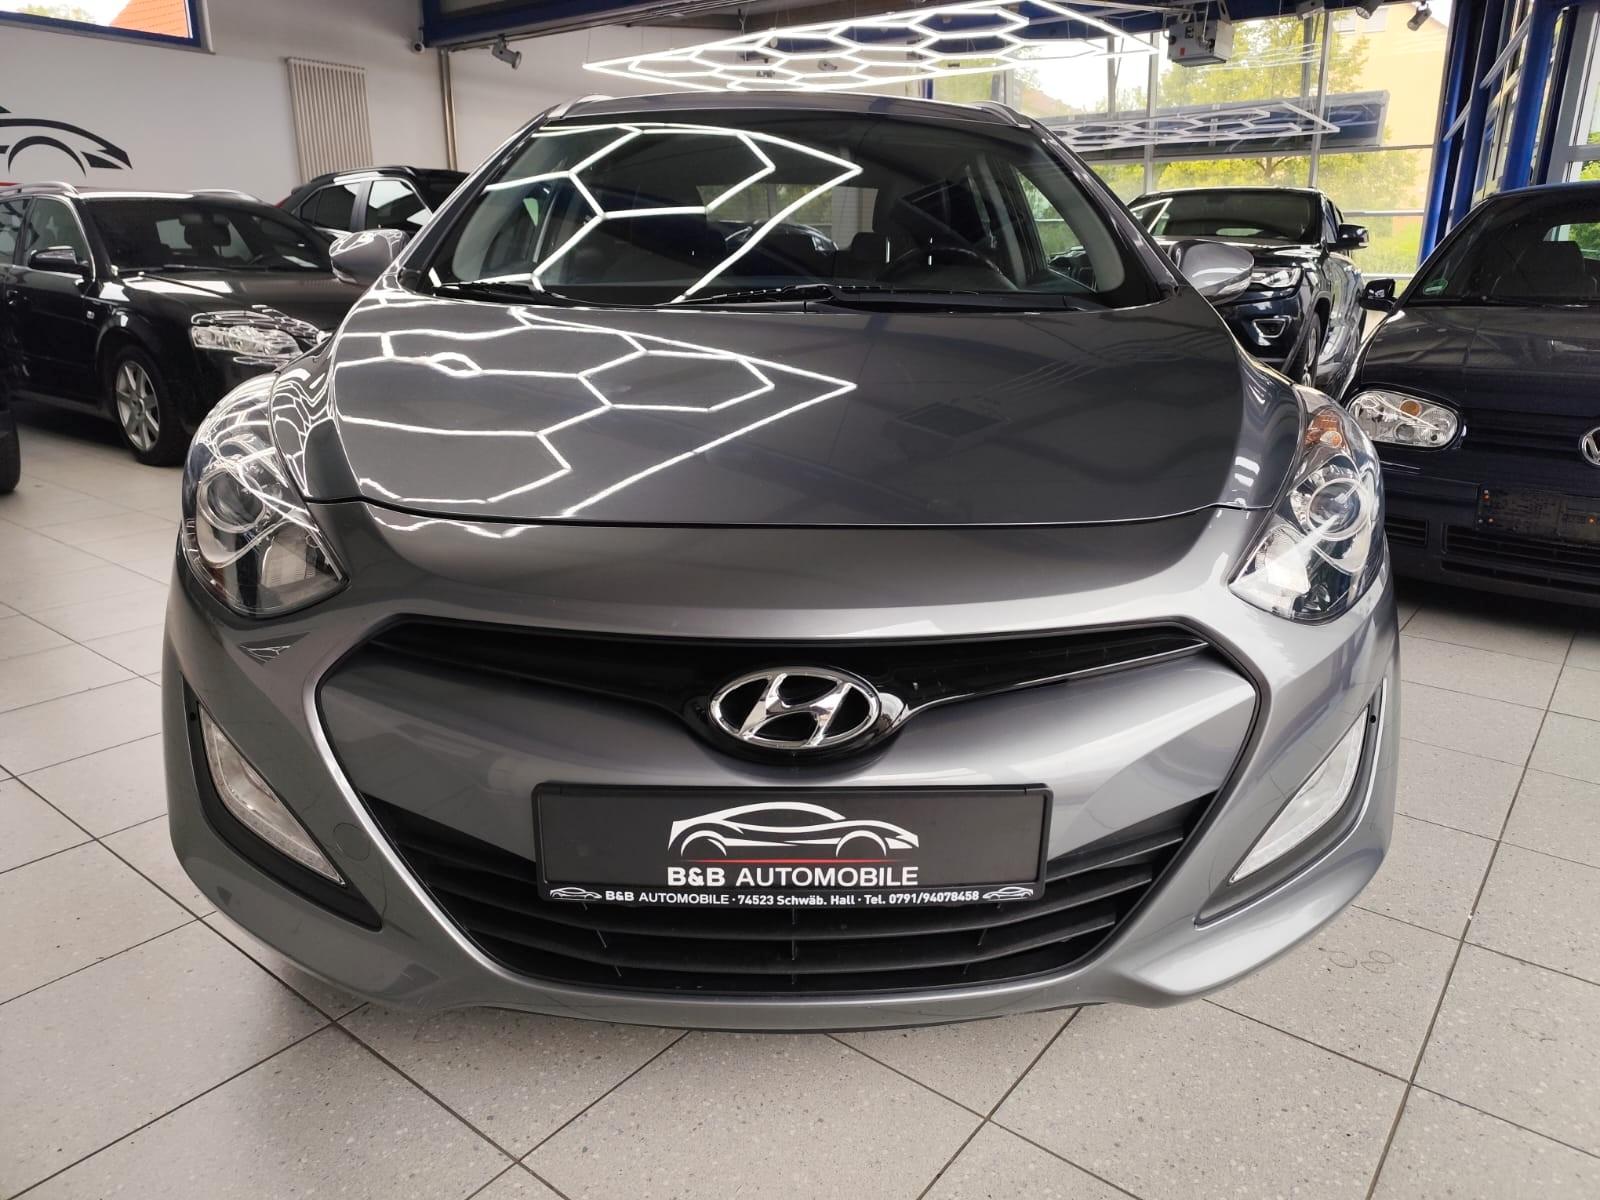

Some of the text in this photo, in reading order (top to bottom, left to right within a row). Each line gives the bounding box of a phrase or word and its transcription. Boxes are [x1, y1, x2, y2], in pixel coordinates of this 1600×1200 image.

[667, 866, 919, 887] B&B AUTOMOBILE
[605, 890, 980, 906] B&B AUTOMOBILE 74523 Schwäb. Hall Tel. 0791/94078458
